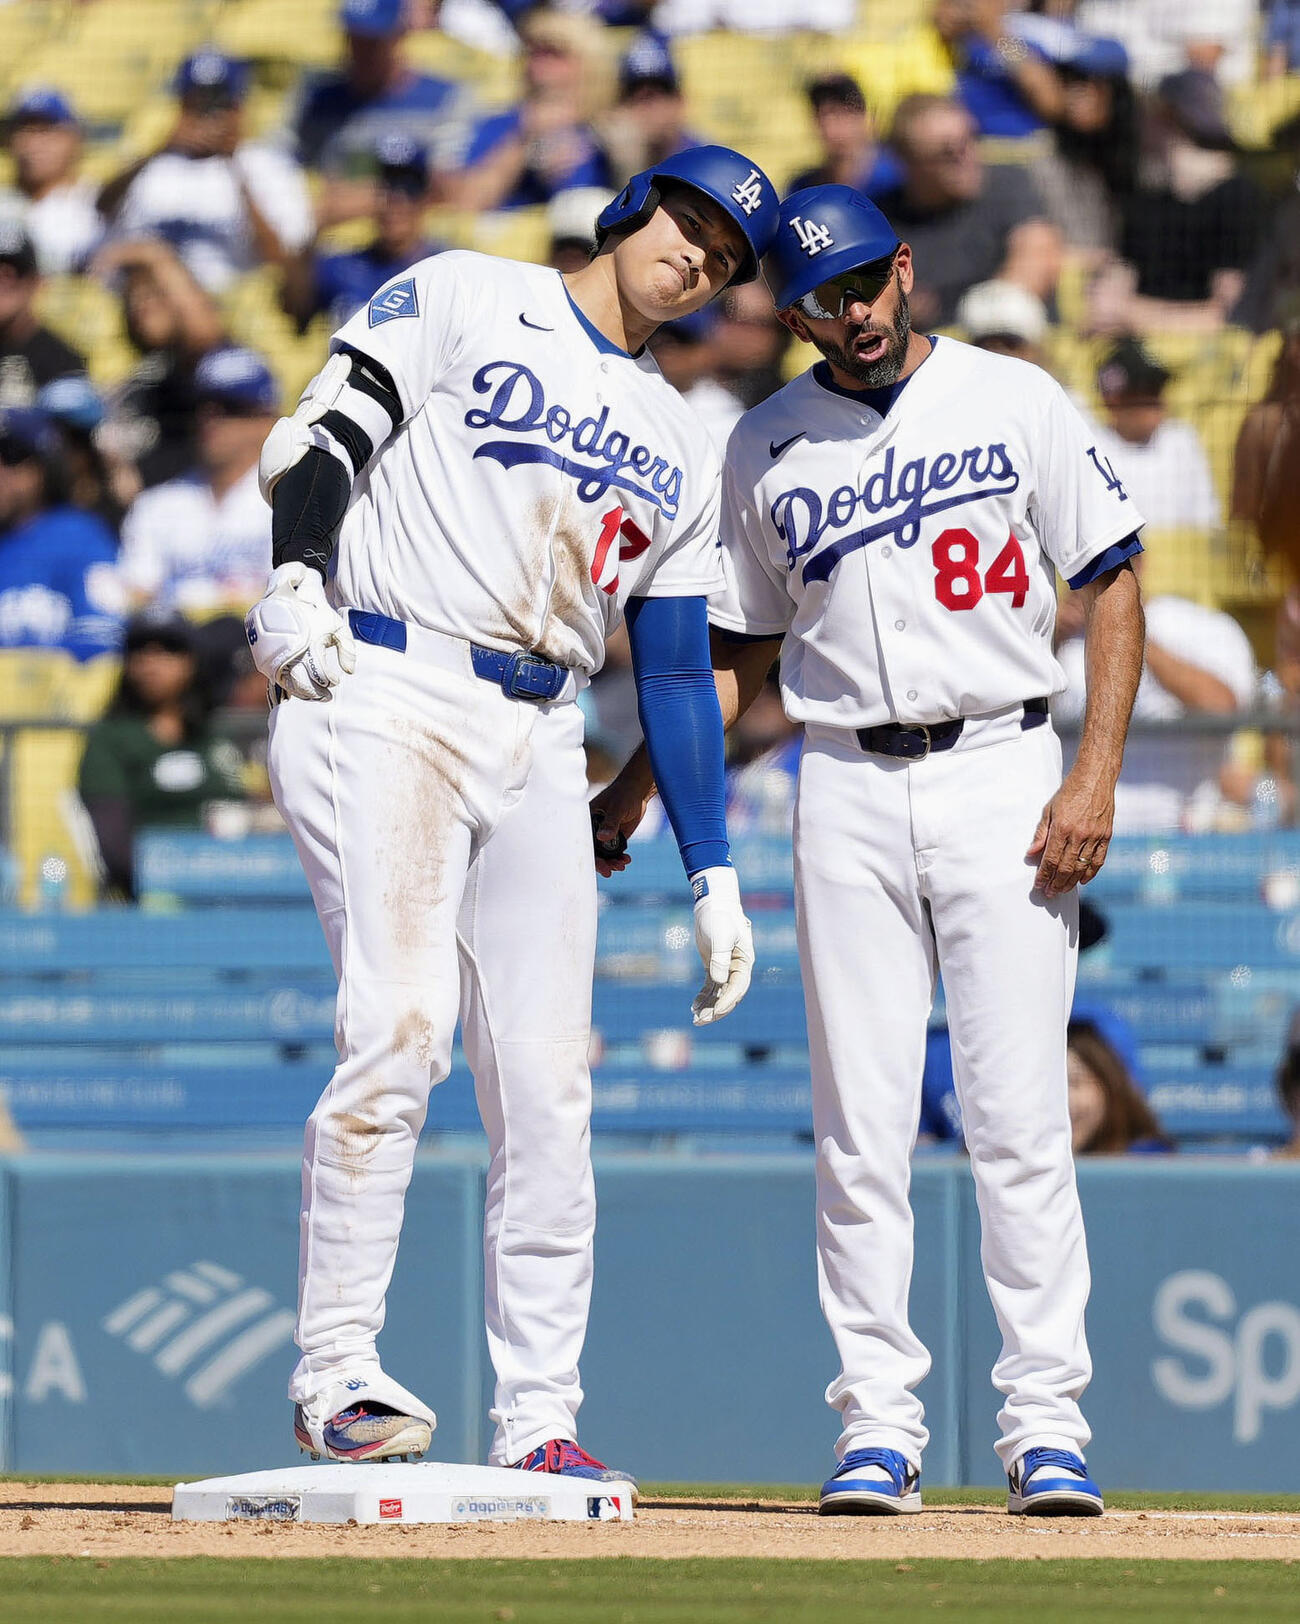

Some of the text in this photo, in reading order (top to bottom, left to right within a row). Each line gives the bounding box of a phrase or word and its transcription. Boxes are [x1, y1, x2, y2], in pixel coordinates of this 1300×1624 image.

[731, 169, 762, 215] LA
[789, 216, 834, 256] LA
[464, 360, 683, 518] Dodgers
[770, 442, 1020, 572] Dodgers
[931, 527, 1030, 612] 84
[0, 1312, 88, 1403] A
[1152, 1269, 1300, 1446] Sp
